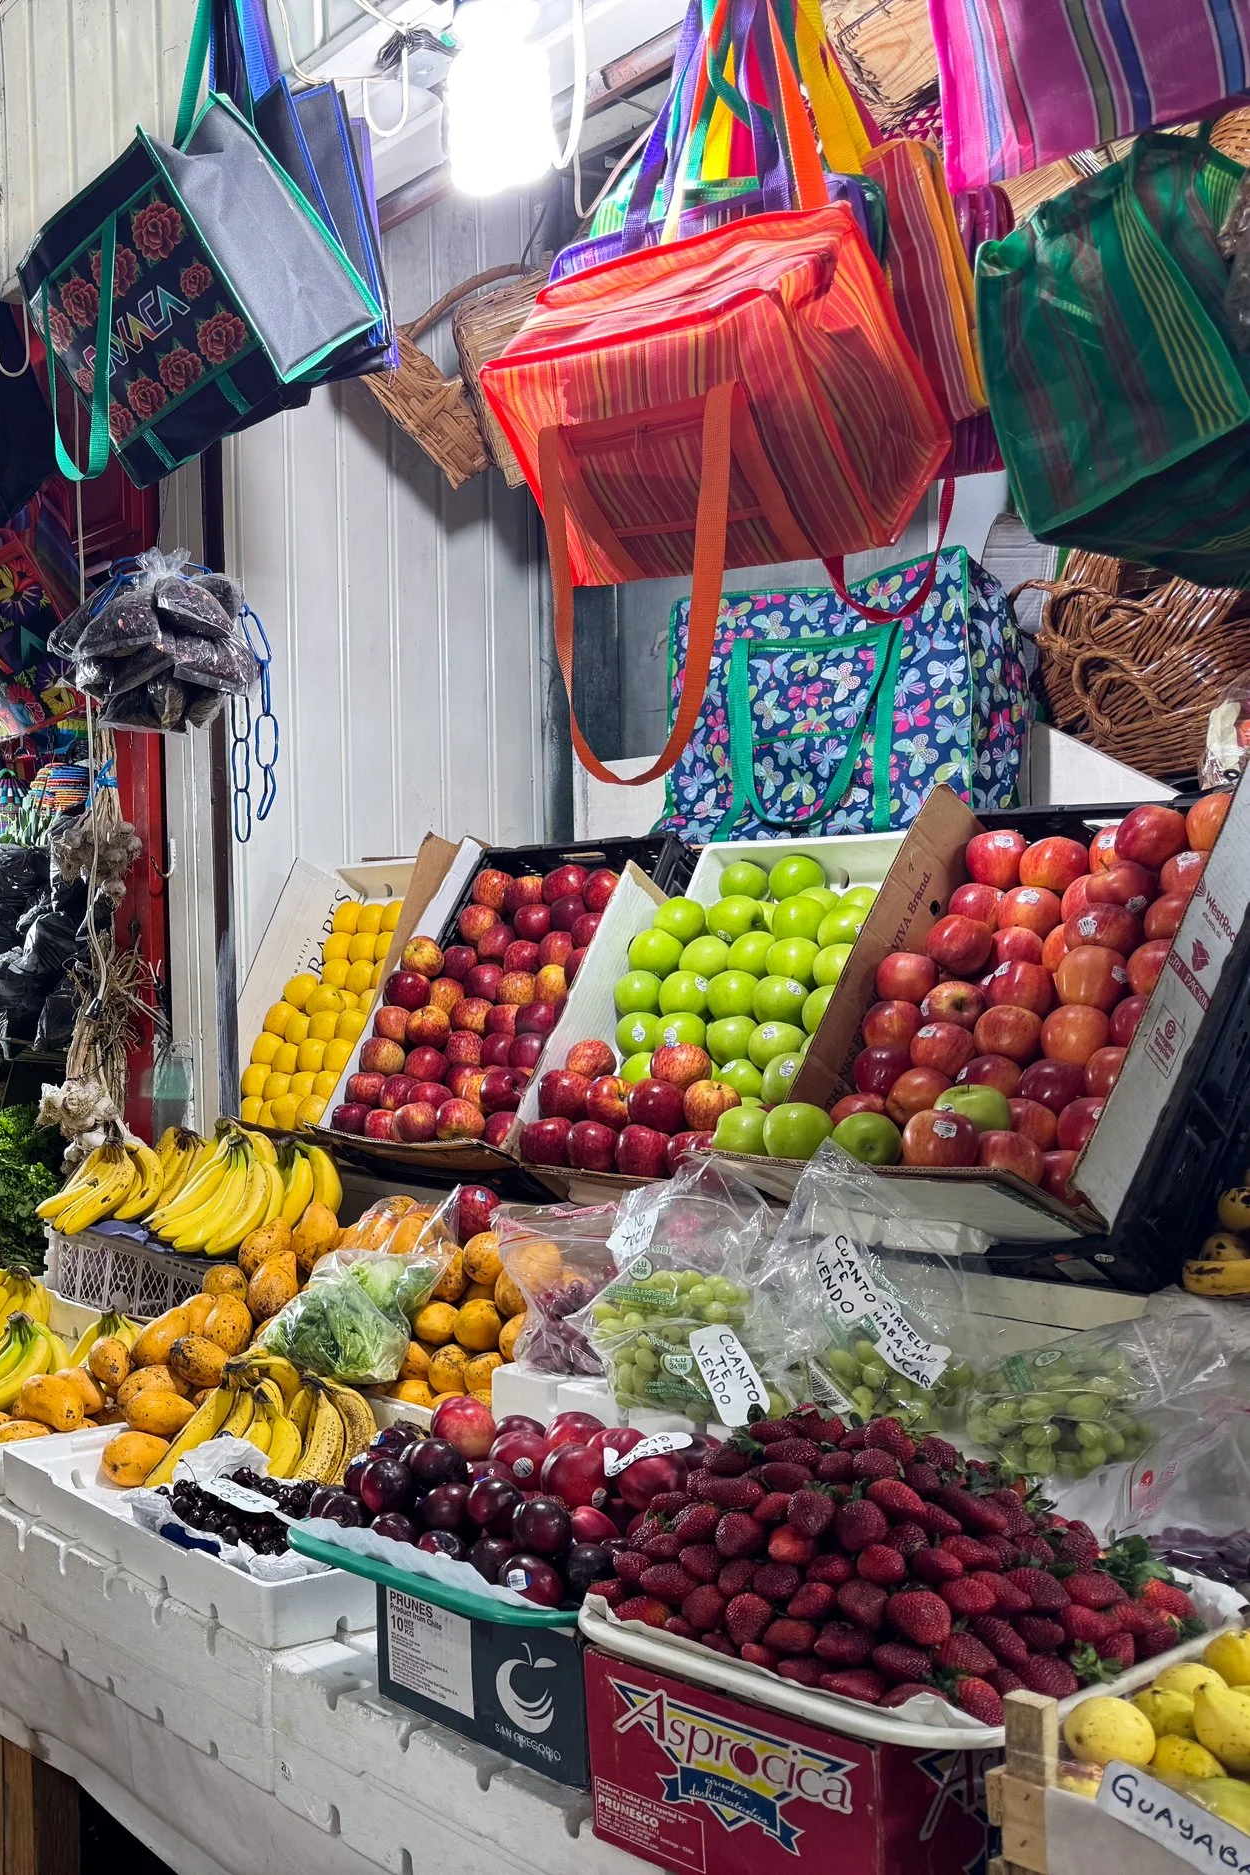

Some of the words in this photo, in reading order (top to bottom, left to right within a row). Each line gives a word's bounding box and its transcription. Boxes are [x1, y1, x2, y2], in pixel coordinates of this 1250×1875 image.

[891, 917, 912, 951] VIVA
[907, 871, 932, 918] Brand.
[1205, 890, 1237, 943] WestRoc
[1184, 973, 1210, 1013] PACKIN
[634, 1213, 646, 1228] NO
[816, 1252, 854, 1313] VENDO
[833, 1258, 849, 1282] TE
[835, 1235, 877, 1303] CUANTO
[697, 1344, 731, 1405] VENDO
[715, 1355, 732, 1380] TE
[719, 1333, 760, 1402] CUANTO
[390, 1591, 433, 1618] PRUNES
[390, 1603, 412, 1617] Product
[412, 1612, 426, 1624] from
[426, 1618, 442, 1630] Chile
[391, 1614, 404, 1632] 10
[404, 1628, 414, 1637] KG
[494, 1723, 513, 1740] SAN
[704, 1776, 749, 1799] ciruelas
[597, 1793, 659, 1829] PRUNESCO
[688, 1783, 770, 1826] deshidratadas
